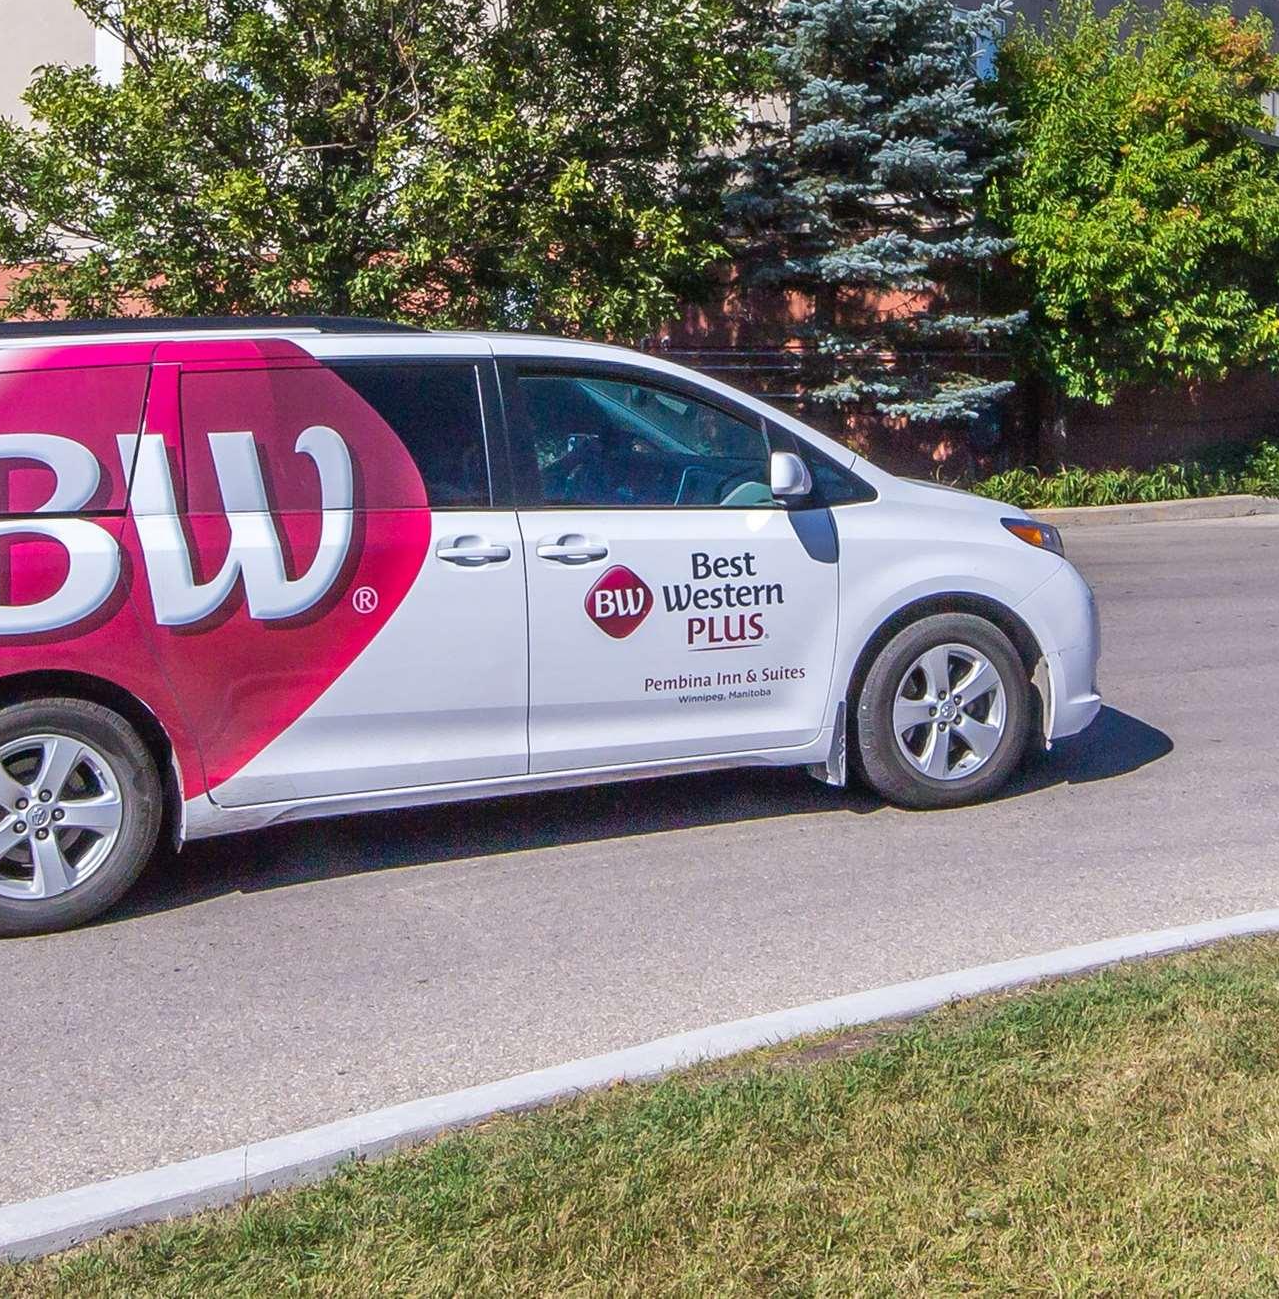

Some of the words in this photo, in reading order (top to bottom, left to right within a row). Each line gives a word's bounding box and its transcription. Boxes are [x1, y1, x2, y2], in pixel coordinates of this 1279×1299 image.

[691, 552, 757, 580] Best
[594, 587, 645, 620] BW
[662, 583, 785, 613] Western
[687, 612, 765, 645] PLUS
[644, 674, 712, 692] Pembina
[716, 672, 742, 686] Inn
[746, 669, 758, 683] &
[761, 666, 806, 682] Suites
[678, 692, 726, 704] Winnipeg,
[728, 688, 772, 700] Manitoba
